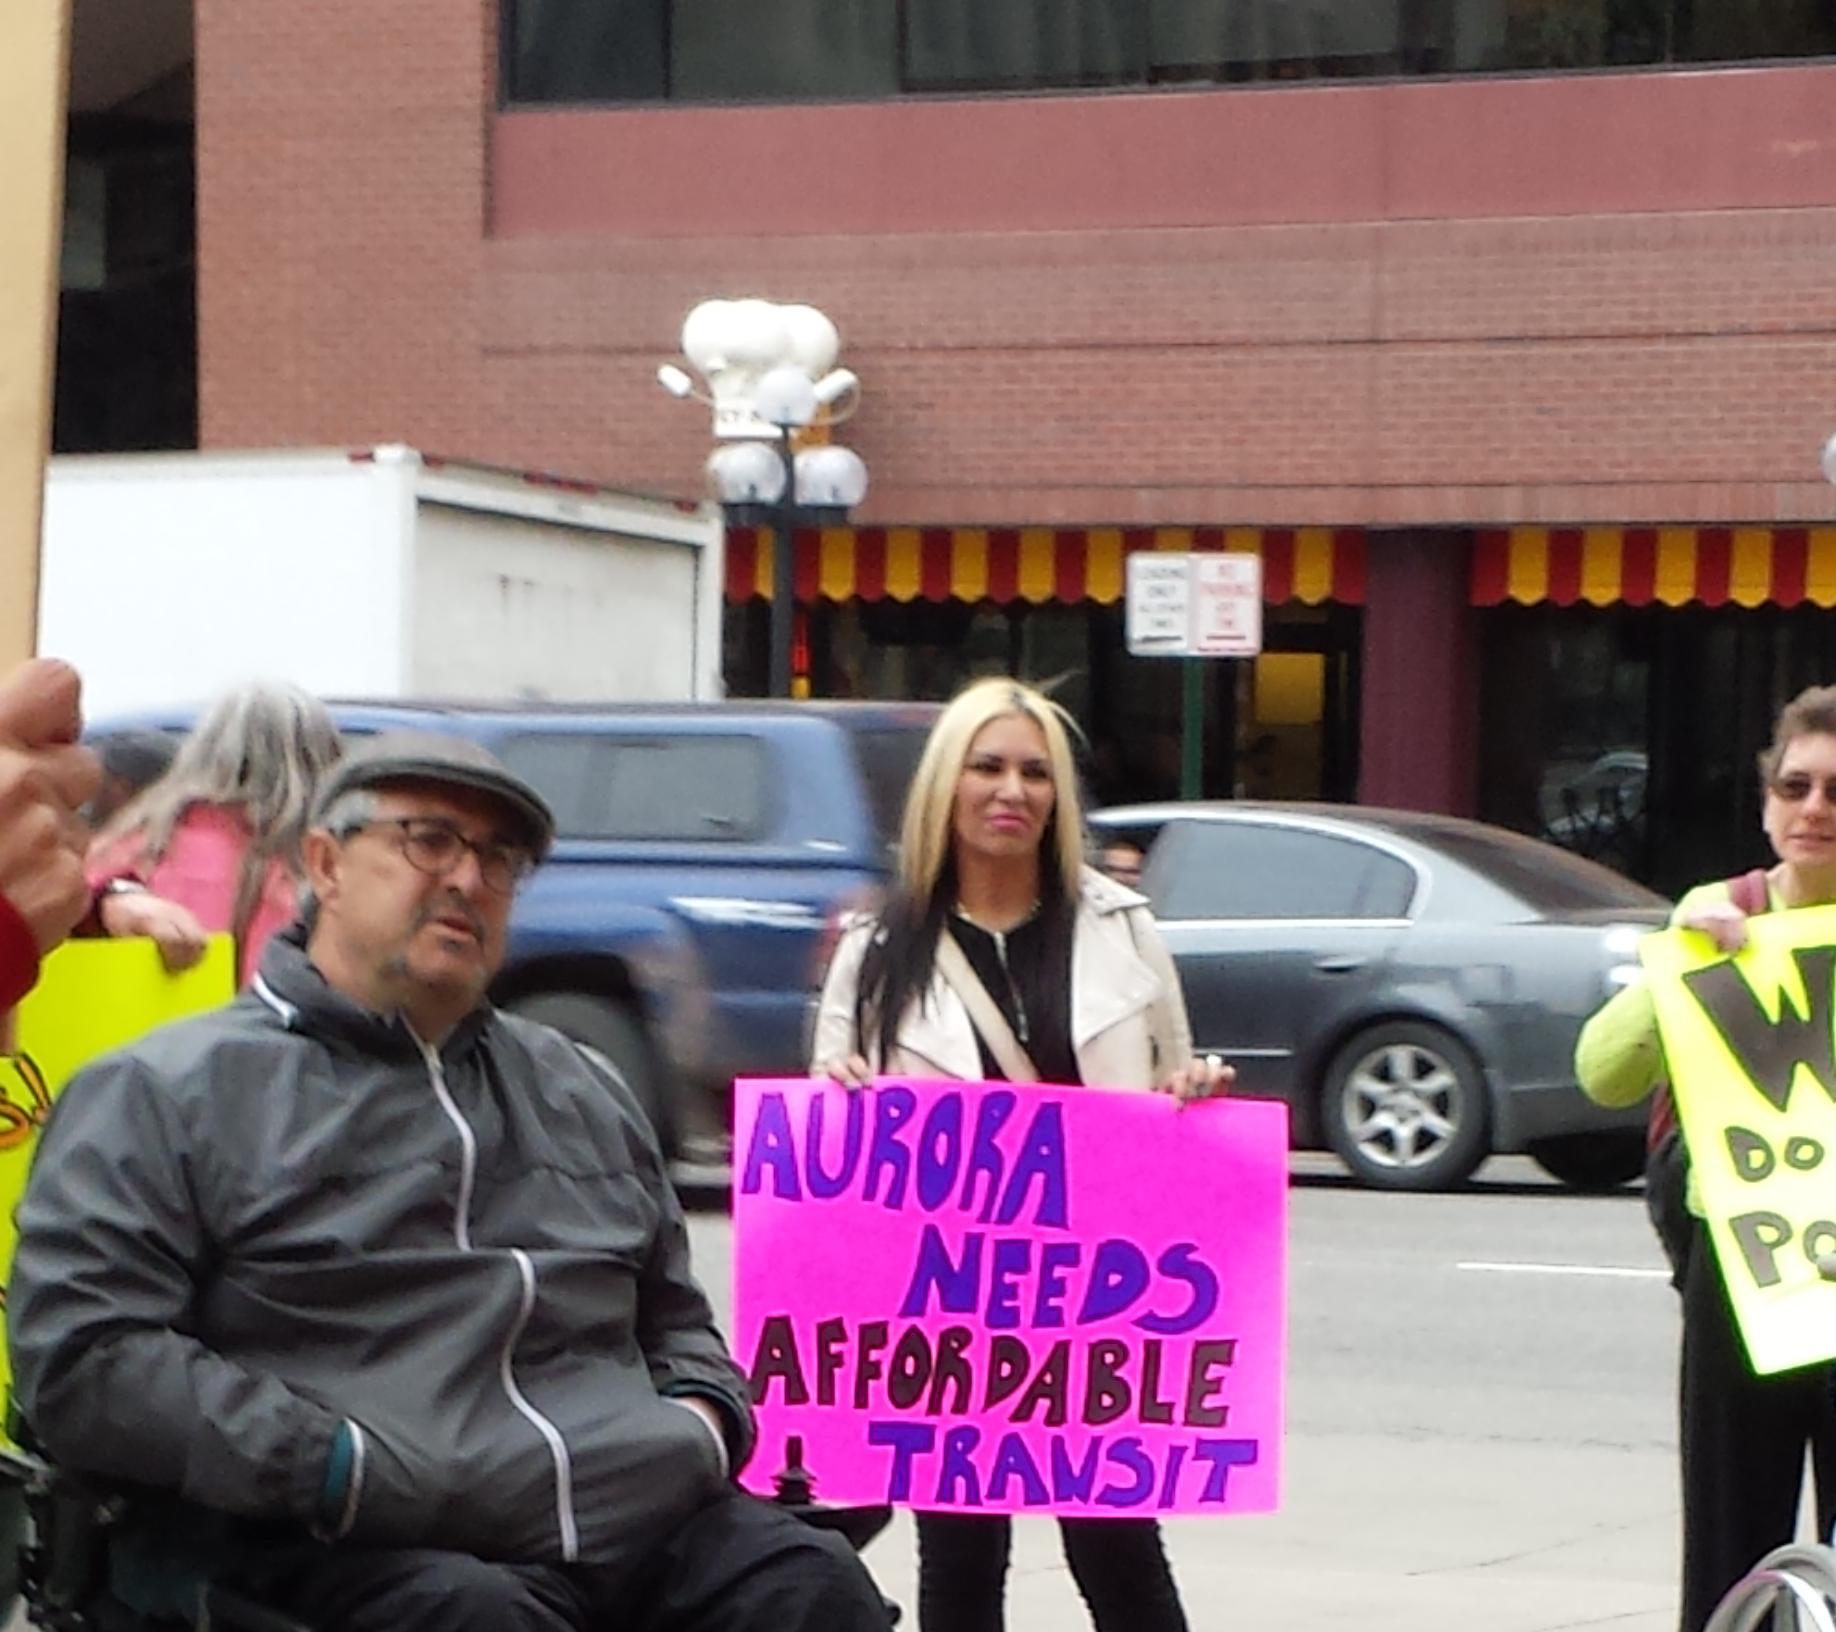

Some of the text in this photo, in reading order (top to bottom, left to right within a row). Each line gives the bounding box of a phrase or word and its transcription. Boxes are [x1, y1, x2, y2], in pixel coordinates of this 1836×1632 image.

[742, 1086, 1069, 1230] AURORA
[898, 1223, 1220, 1335] NEEDS
[751, 1316, 1238, 1427] AFFORDABLE
[868, 1421, 1258, 1509] TRANSIT
